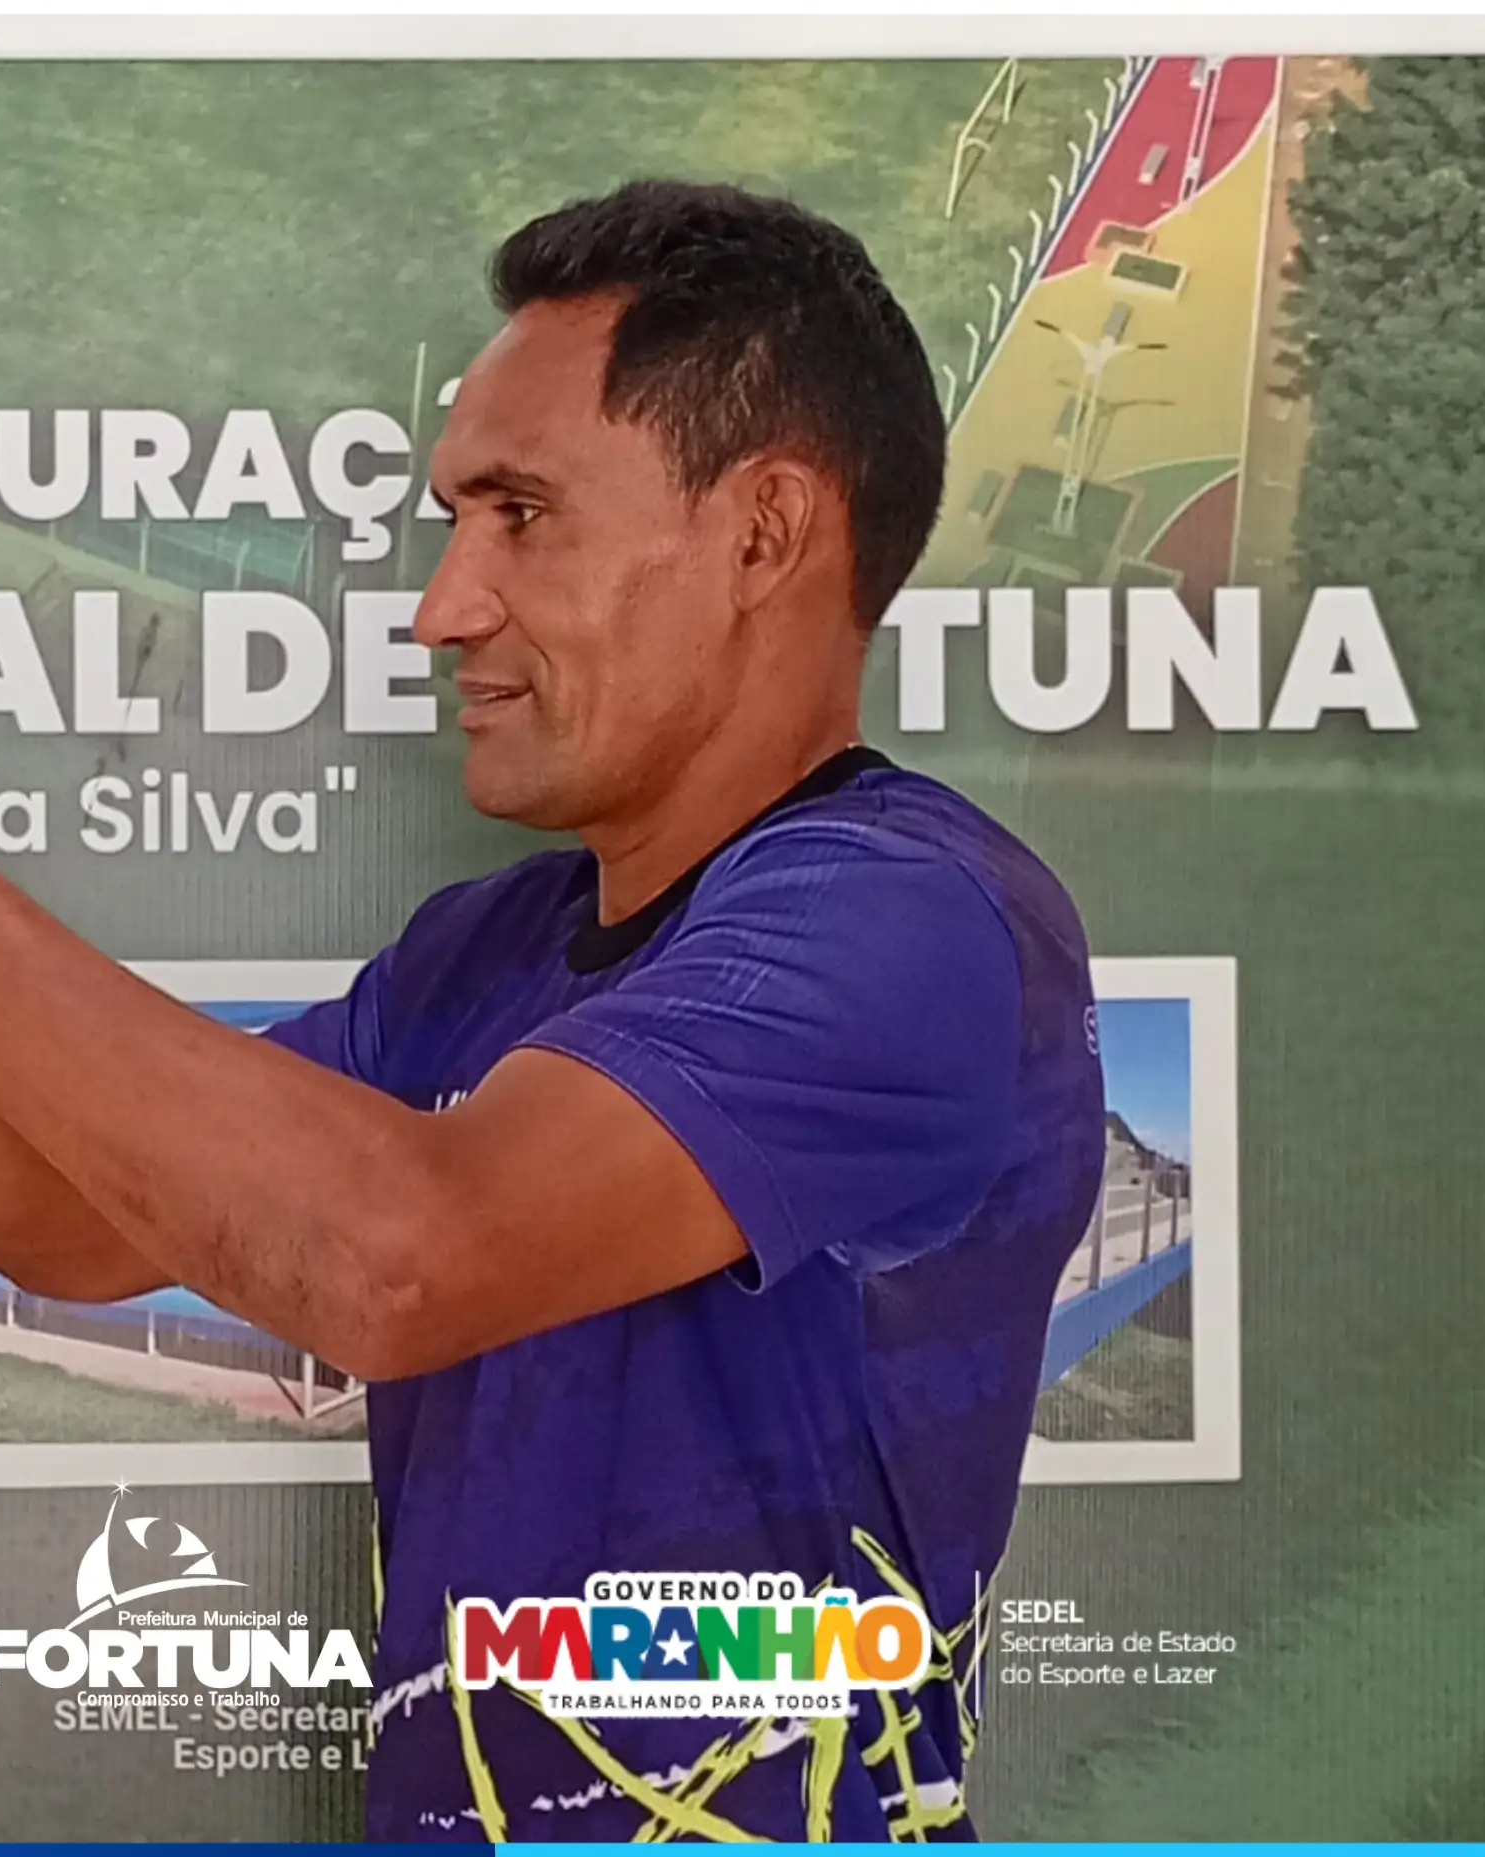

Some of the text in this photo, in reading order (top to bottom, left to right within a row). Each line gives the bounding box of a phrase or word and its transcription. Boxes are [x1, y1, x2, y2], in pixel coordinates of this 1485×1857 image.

[202, 590, 438, 734] DE
[53, 1699, 179, 1732] SEMEL
[173, 1737, 311, 1777] Esporte
[320, 1745, 342, 1770] e
